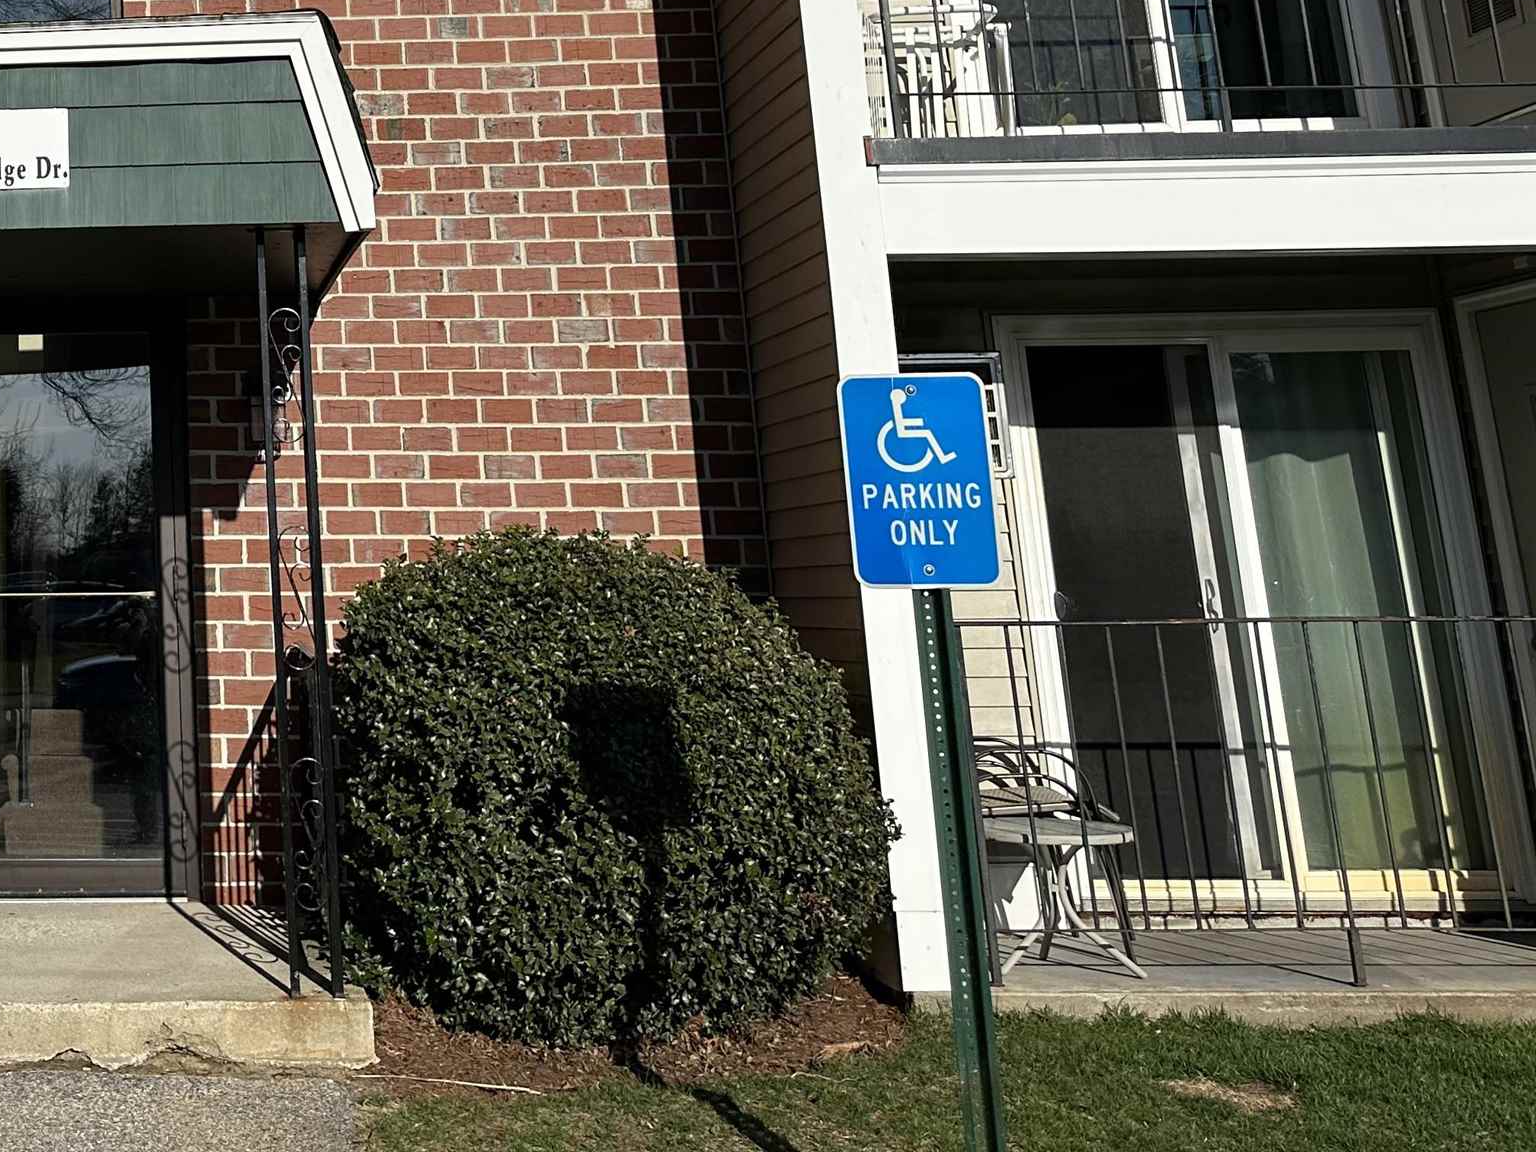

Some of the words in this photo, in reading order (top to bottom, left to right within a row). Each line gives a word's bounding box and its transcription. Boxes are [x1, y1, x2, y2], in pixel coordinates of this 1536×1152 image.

[36, 156, 68, 179] Dr.
[862, 482, 982, 510] PARKING
[890, 519, 959, 546] ONLY
